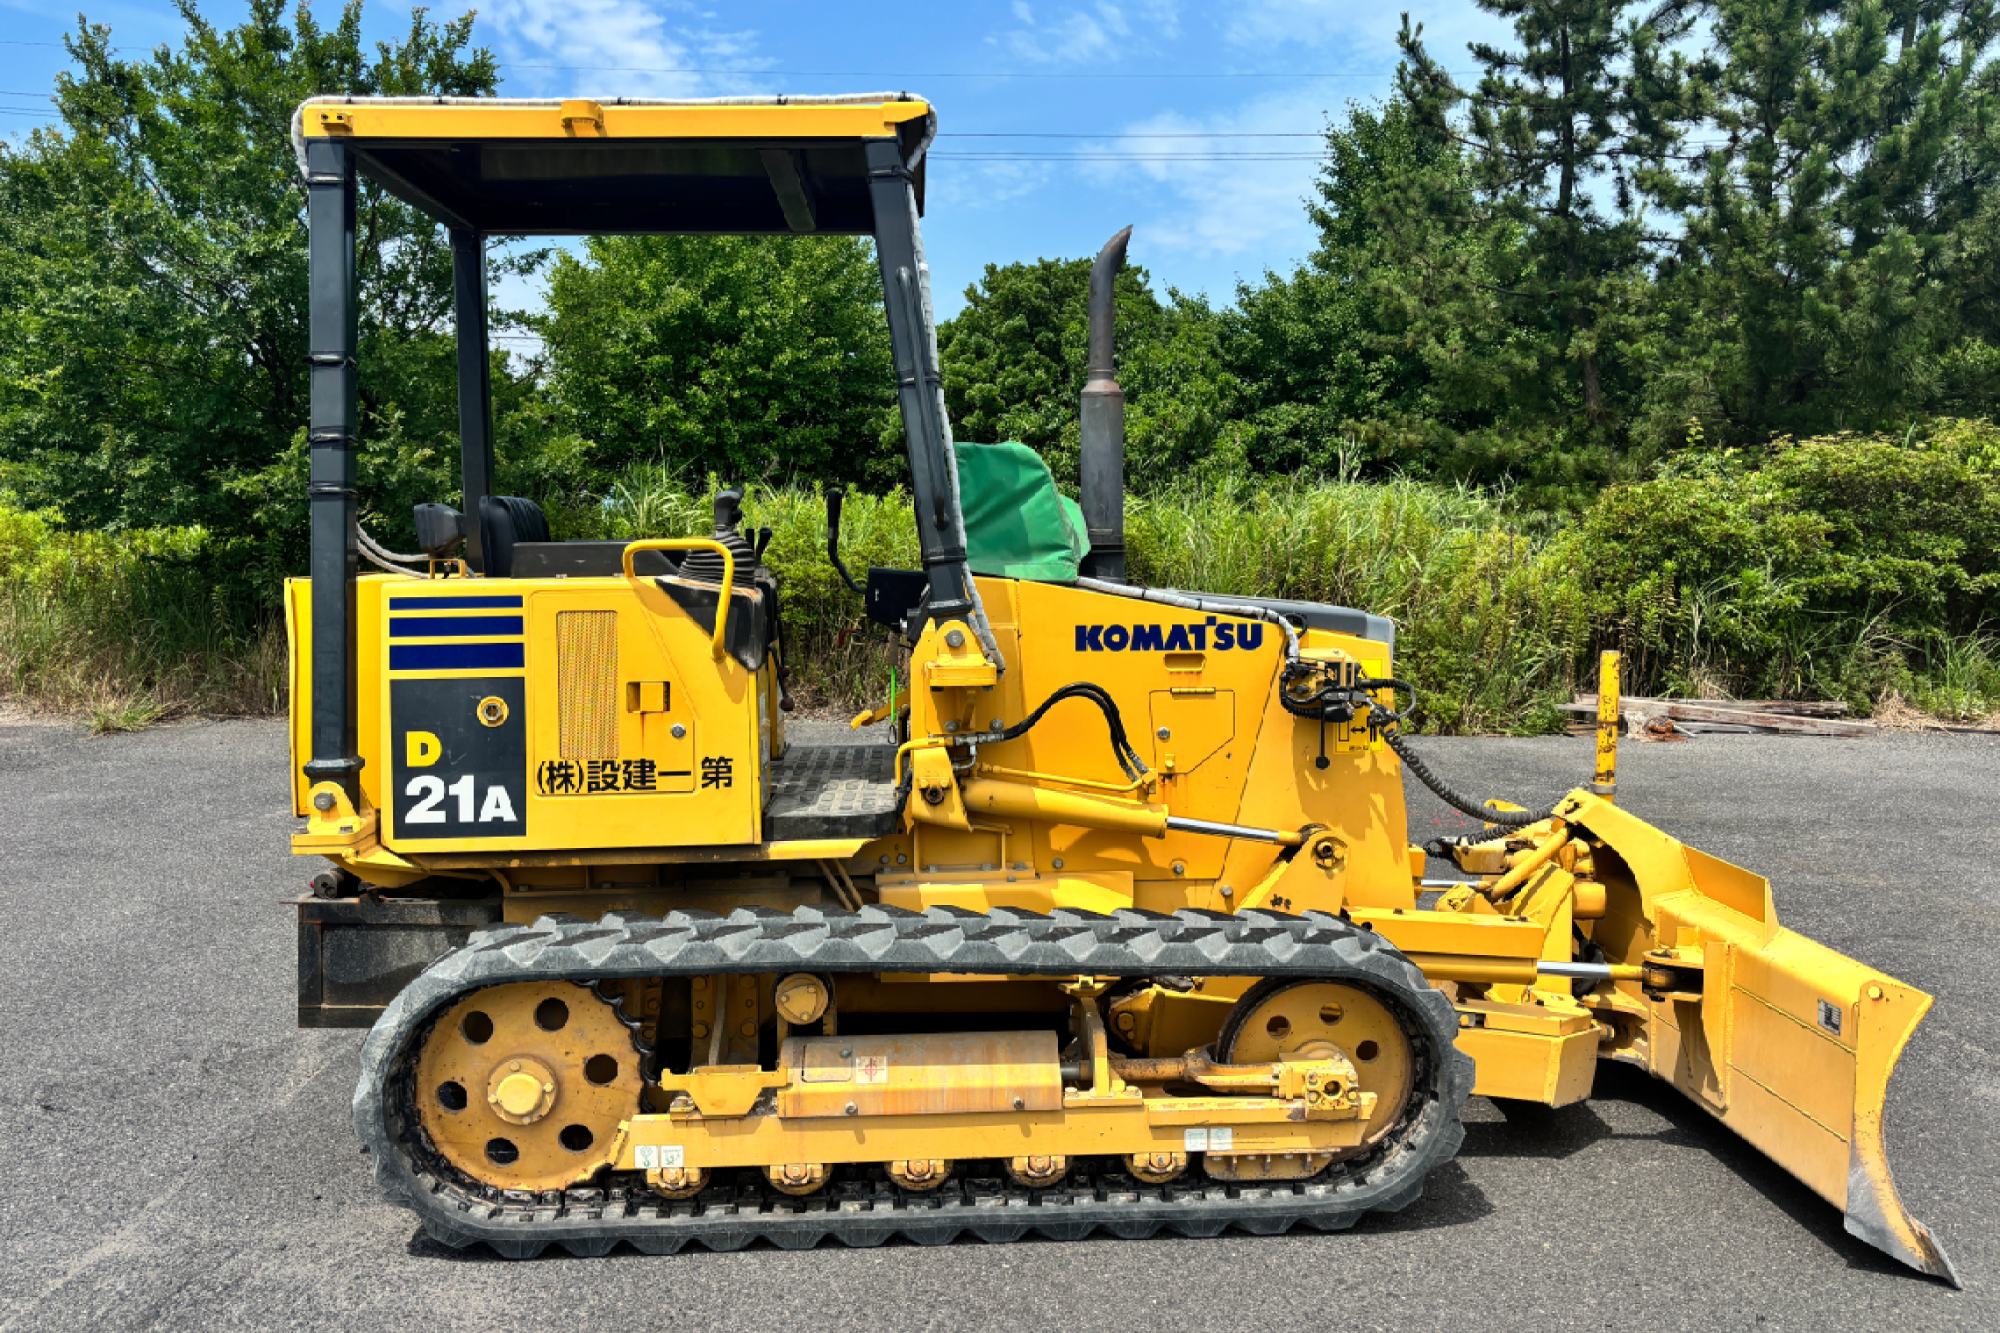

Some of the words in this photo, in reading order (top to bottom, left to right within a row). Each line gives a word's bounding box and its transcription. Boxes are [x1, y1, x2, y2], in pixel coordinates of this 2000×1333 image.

[1075, 616, 1263, 652] KOMATSU
[406, 731, 442, 767] D
[404, 774, 518, 824] 21A
